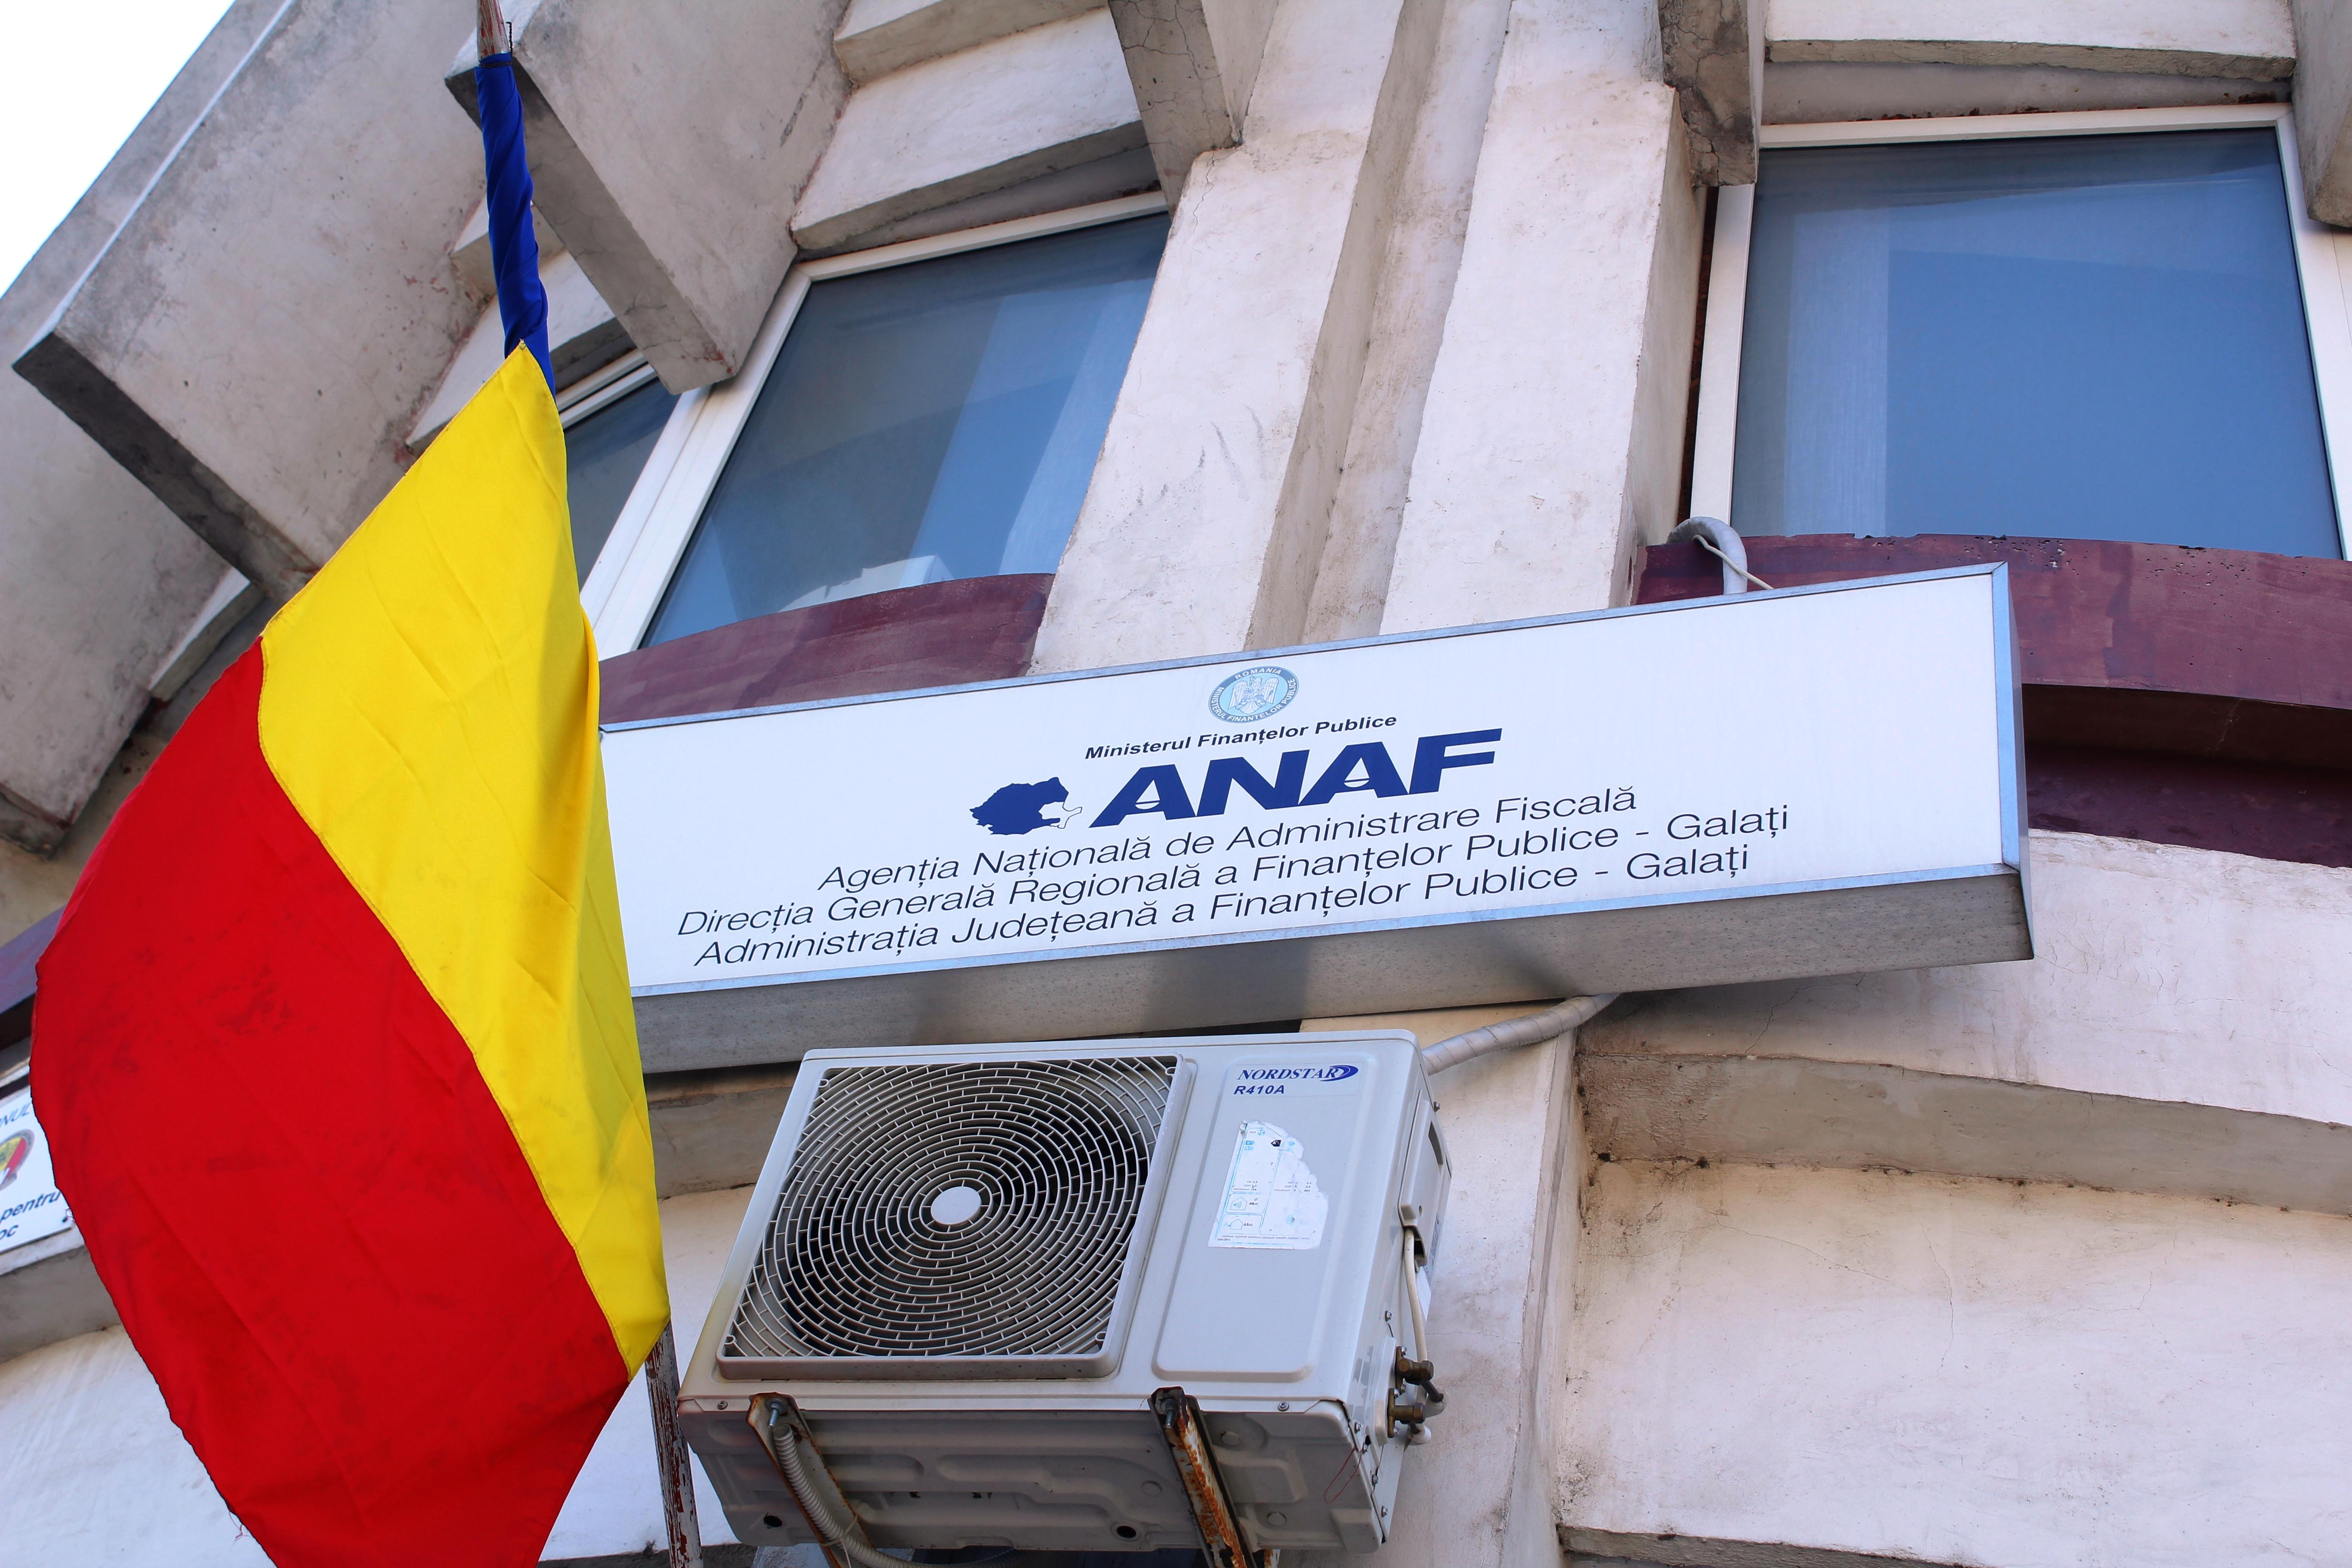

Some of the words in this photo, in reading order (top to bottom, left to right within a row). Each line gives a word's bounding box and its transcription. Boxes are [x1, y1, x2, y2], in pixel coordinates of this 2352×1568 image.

[1234, 667, 1282, 680] ROMANIA
[1210, 686, 1227, 720] MINISTERUL
[1281, 677, 1297, 705] PUBLICE
[1085, 737, 1191, 760] Ministerul
[1198, 726, 1309, 747] Finanțelor
[1315, 717, 1397, 734] Publice
[1089, 728, 1503, 828] ANAF
[817, 857, 959, 893] Agenția
[973, 836, 1151, 877] Națională
[1166, 832, 1214, 857] de
[1225, 808, 1480, 851] Administrare
[1496, 786, 1637, 823] Fiscală
[677, 902, 813, 936] Direcția
[828, 882, 995, 921] Generală
[1009, 863, 1200, 905] Regională
[1215, 866, 1237, 885] a
[1253, 843, 1453, 881] Finanțelor
[1466, 826, 1618, 860] Publice
[1667, 804, 1787, 840] Galați
[693, 923, 938, 966] Administrația
[952, 900, 1157, 943] Județeană
[1171, 903, 1194, 923] a
[1210, 881, 1411, 920] Finanțelor
[1425, 865, 1578, 900] Publice
[1627, 843, 1748, 880] Galați
[1233, 1084, 1285, 1095] R410A
[1236, 1067, 1340, 1081] NORDSTAR
[0, 1191, 61, 1223] pentru
